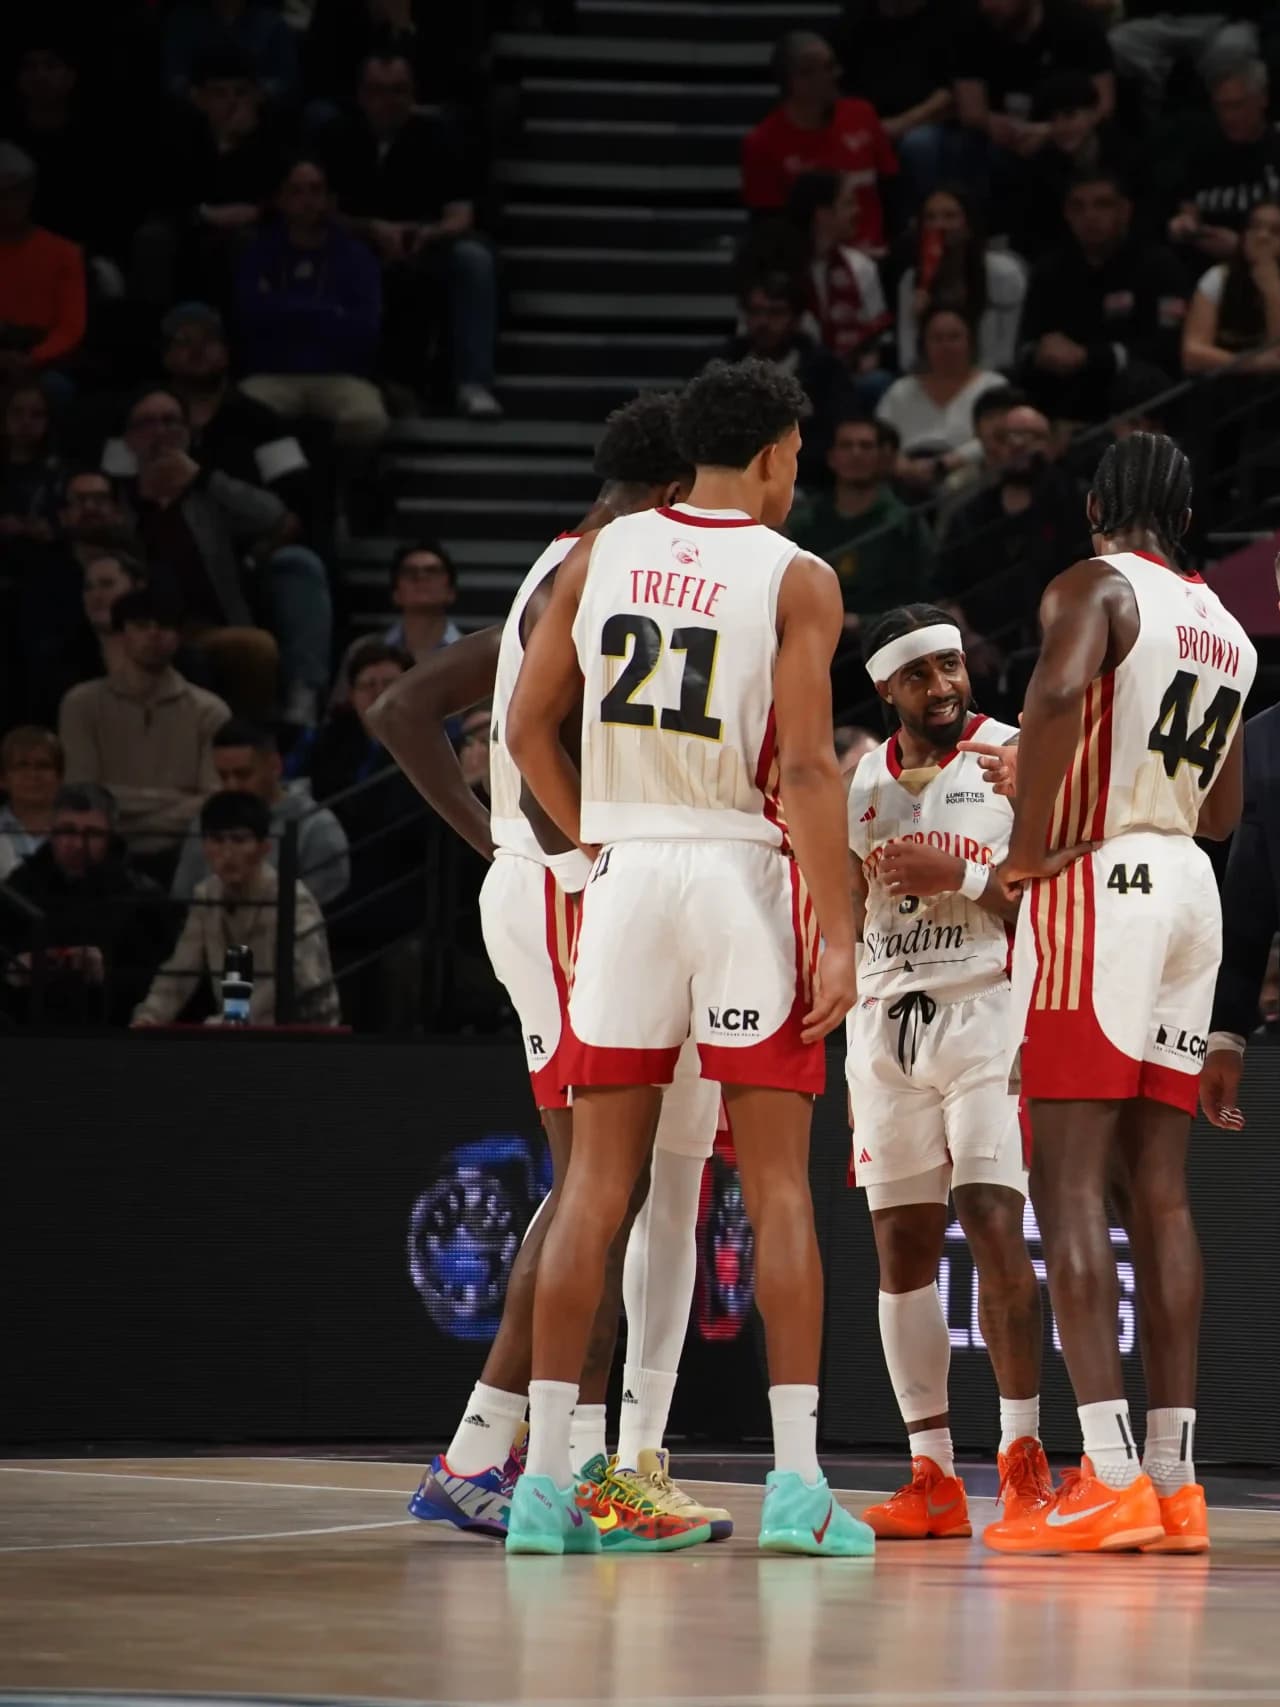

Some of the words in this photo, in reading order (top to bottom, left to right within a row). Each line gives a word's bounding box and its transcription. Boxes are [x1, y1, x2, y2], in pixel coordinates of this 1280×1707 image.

[630, 570, 727, 617] TREFLE
[600, 613, 724, 742] 21
[1176, 625, 1239, 677] BROWN
[1147, 669, 1241, 790] 44
[1107, 863, 1152, 894] 44
[434, 1468, 512, 1522] NIKE
